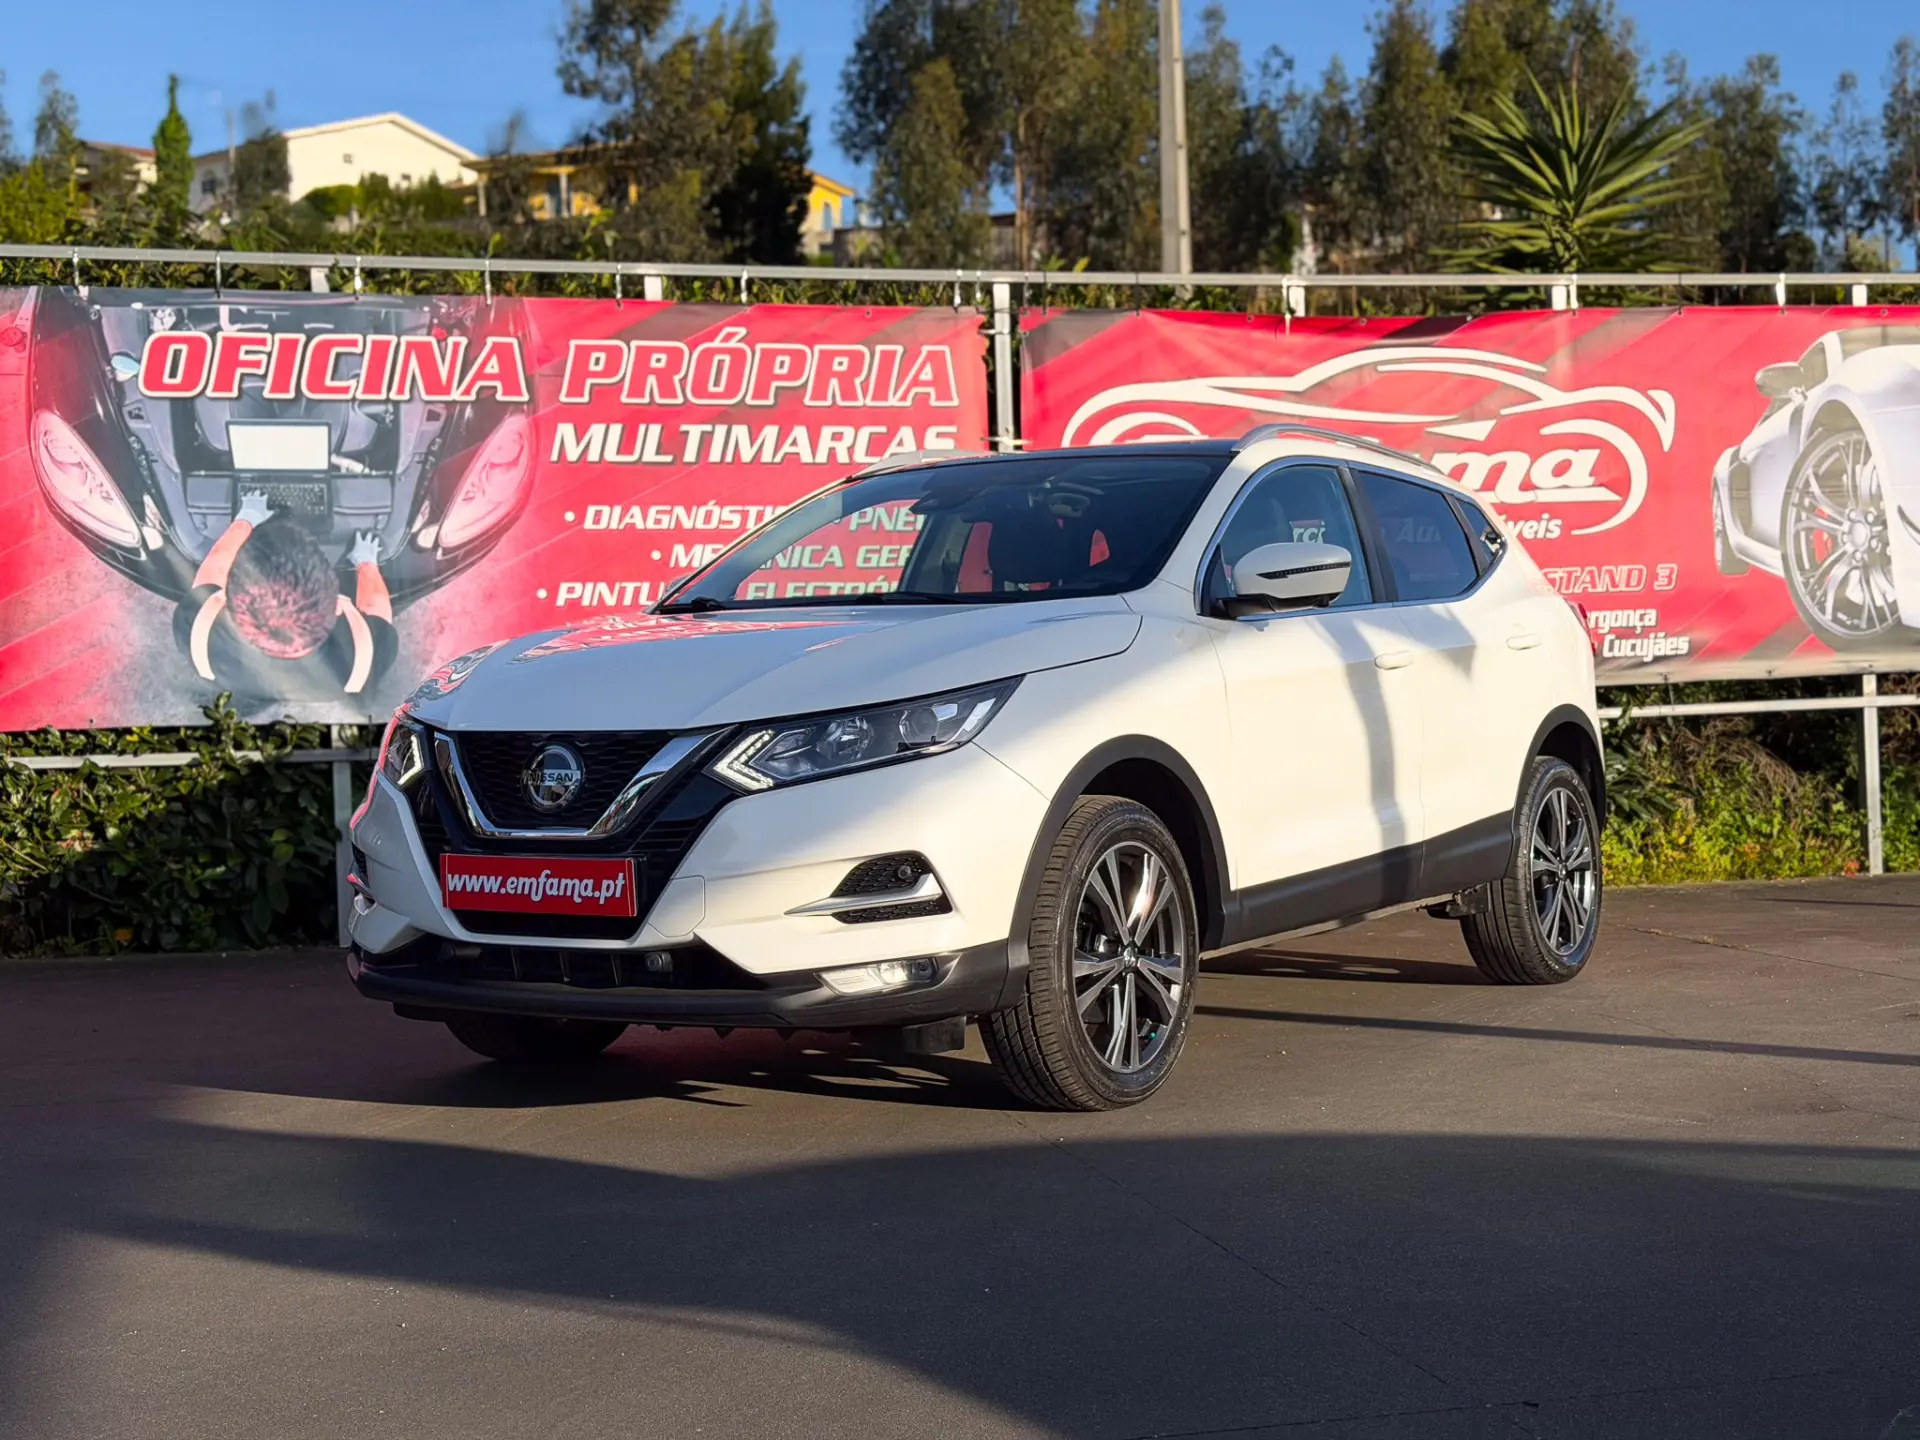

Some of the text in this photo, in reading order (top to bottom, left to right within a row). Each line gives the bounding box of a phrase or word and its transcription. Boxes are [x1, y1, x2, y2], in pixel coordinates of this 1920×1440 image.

[138, 327, 960, 407] OFICINA PRÓPRIA
[551, 423, 957, 464] MULTIMARCAS
[583, 500, 788, 530] DIAGNÓSTI
[1653, 564, 1678, 590] 3
[556, 582, 665, 607] PINTU
[1586, 608, 1657, 633] rgonça
[1602, 632, 1690, 662] Cucujães
[528, 771, 574, 783] NISSAN
[447, 869, 626, 905] www.emfama.pt
